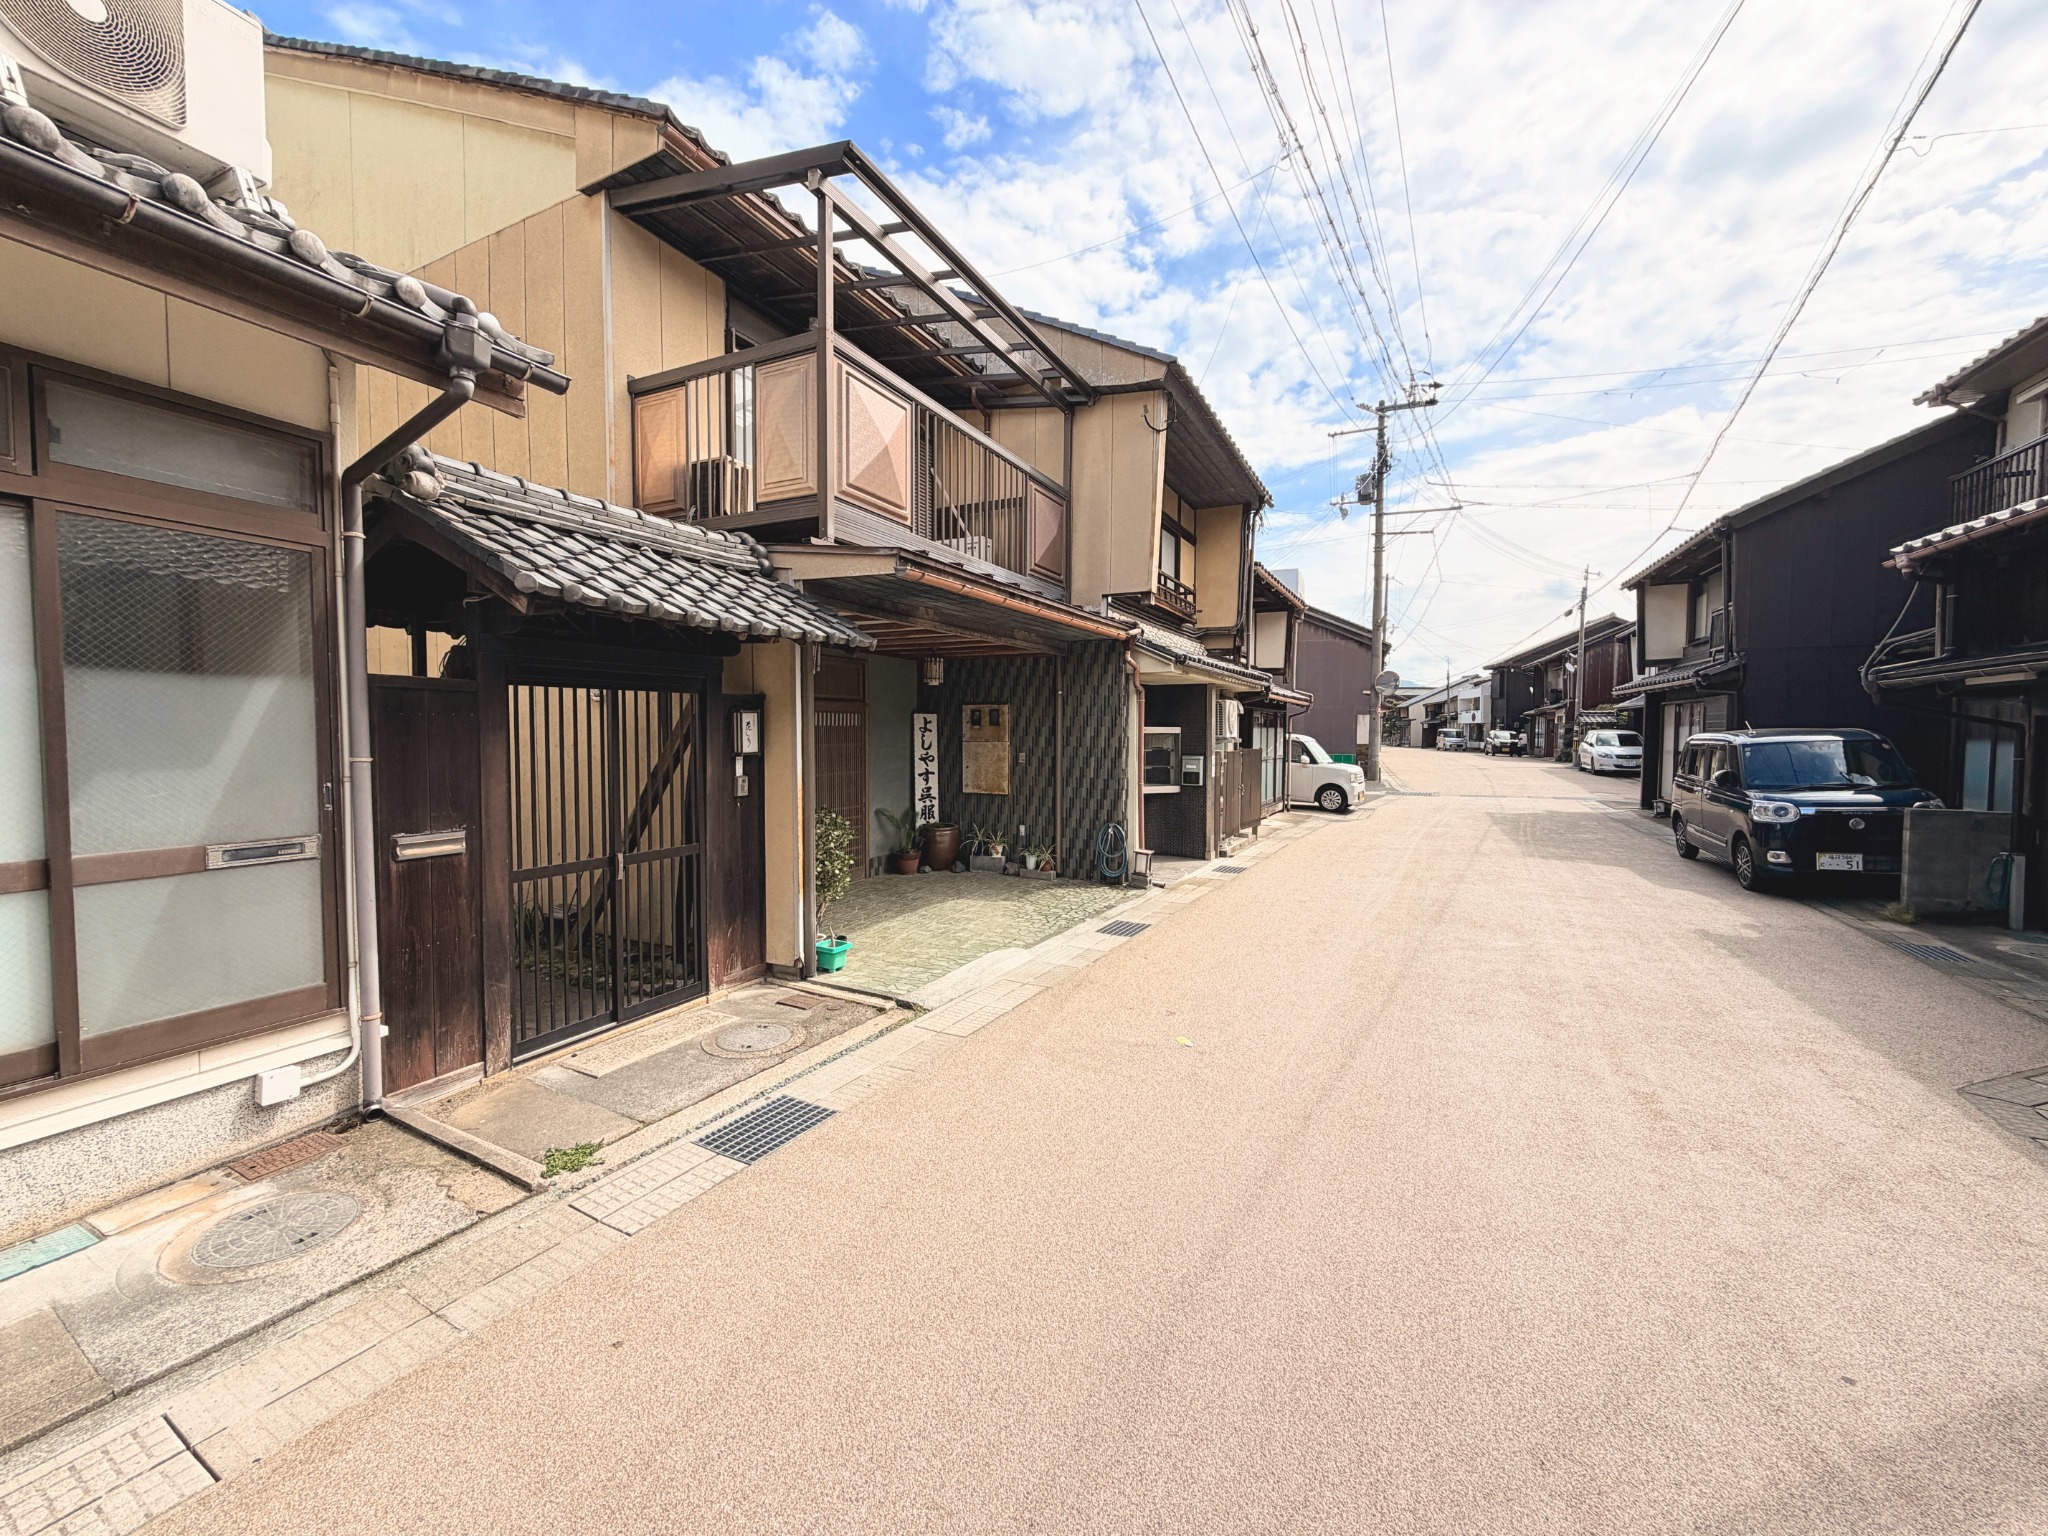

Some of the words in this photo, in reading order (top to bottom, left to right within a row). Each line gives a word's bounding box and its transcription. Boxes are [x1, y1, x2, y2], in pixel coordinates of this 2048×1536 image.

[916, 716, 937, 824] よしやす呉服
